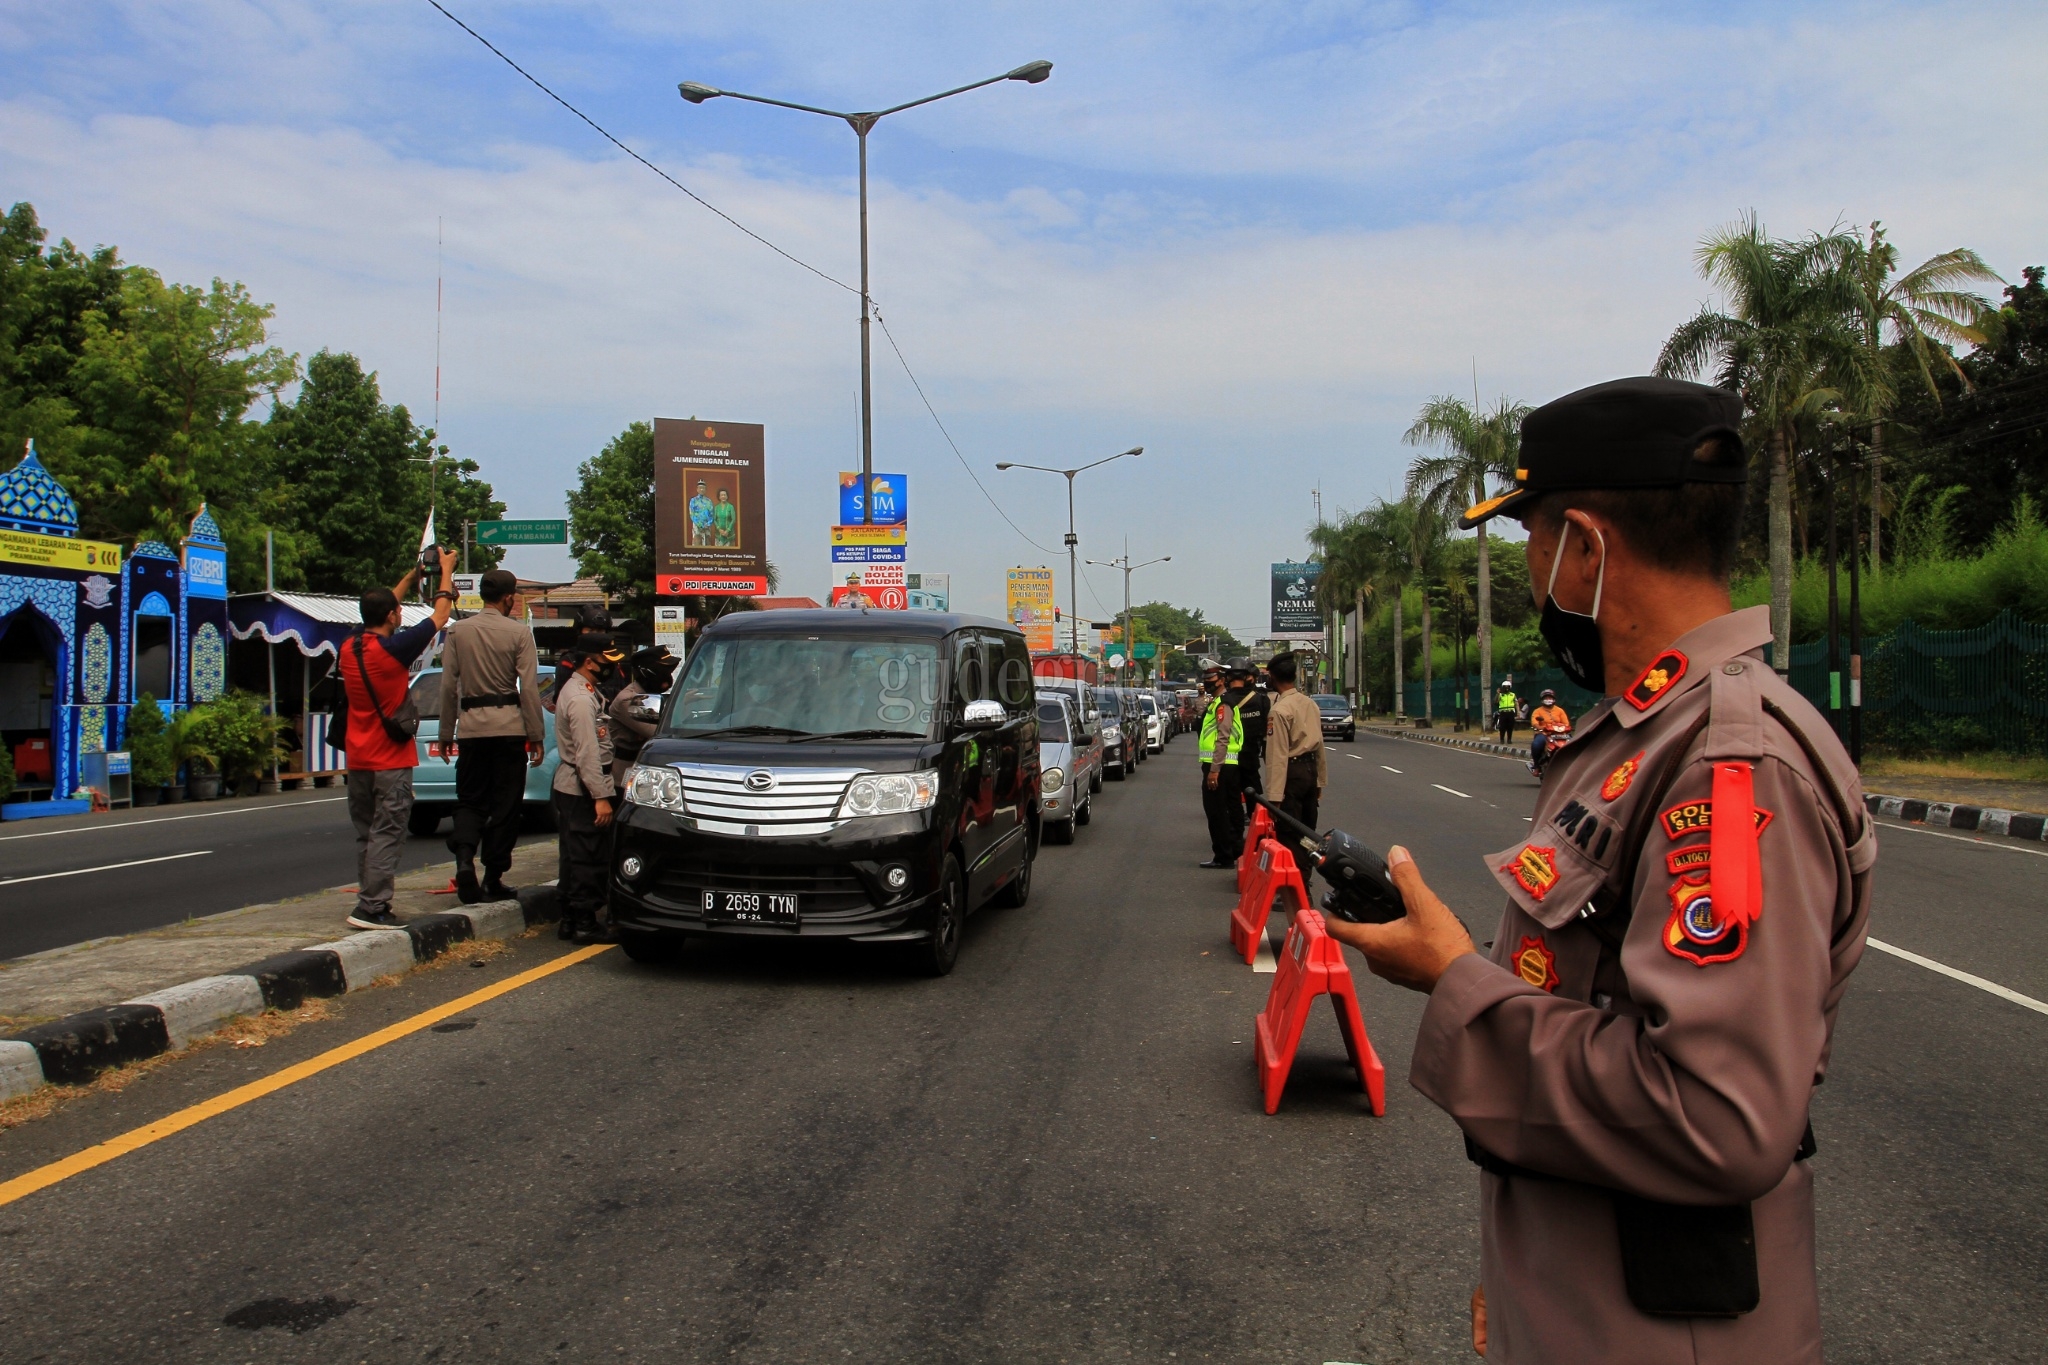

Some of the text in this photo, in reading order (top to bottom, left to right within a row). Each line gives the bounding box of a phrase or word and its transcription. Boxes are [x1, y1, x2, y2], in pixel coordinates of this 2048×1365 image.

[693, 449, 729, 457] TINGALAN
[672, 456, 723, 465] JUMENENGAN
[853, 495, 895, 511] SIM
[3, 543, 57, 556] POLRES SLEMAN
[37, 538, 67, 549] LEBARAN
[67, 542, 82, 552] 2021
[9, 552, 51, 562] PRAMBANAN
[203, 558, 224, 580] BRI
[1017, 571, 1051, 580] STTKD
[684, 581, 755, 590] PDI PERJUANGAN
[1010, 583, 1050, 592] PENERIMAAN
[1277, 600, 1316, 608] SEMAR
[1240, 710, 1261, 719] RIMOB
[705, 892, 794, 914] B 2659 TYN
